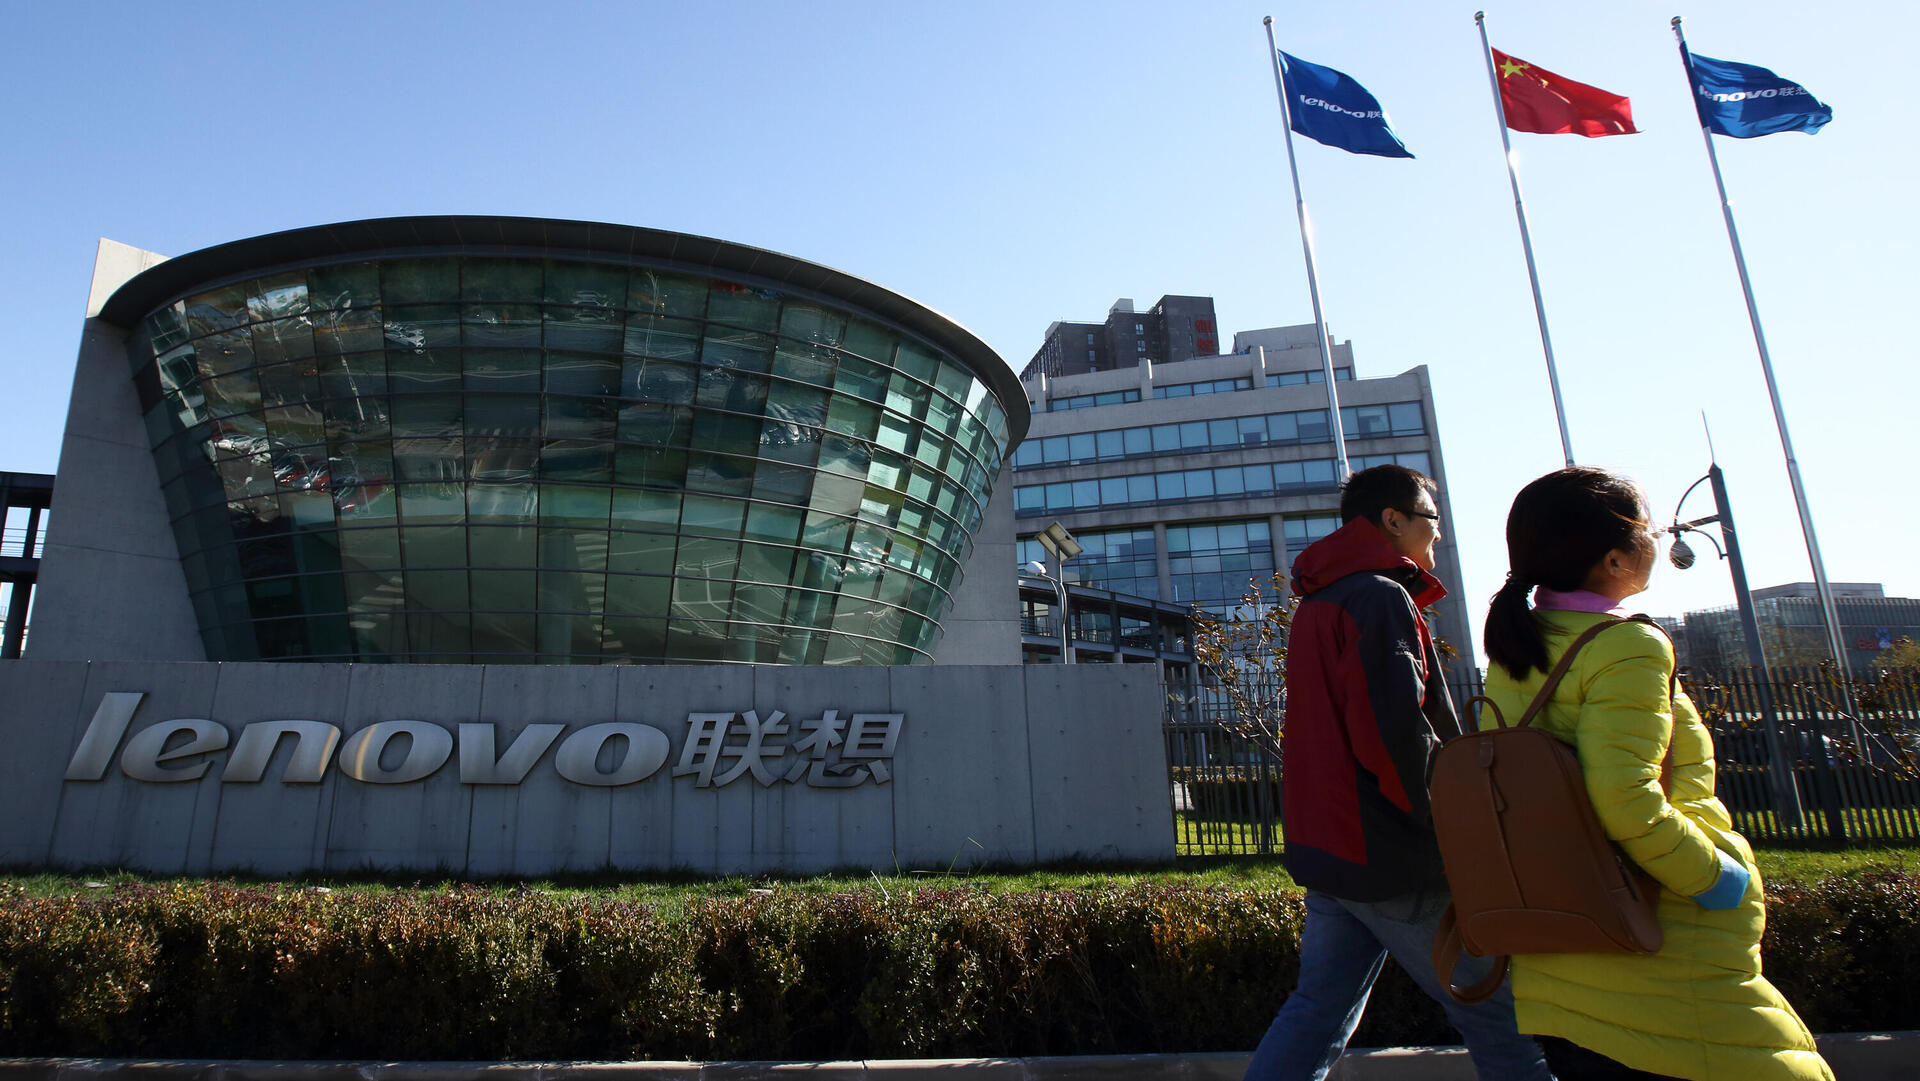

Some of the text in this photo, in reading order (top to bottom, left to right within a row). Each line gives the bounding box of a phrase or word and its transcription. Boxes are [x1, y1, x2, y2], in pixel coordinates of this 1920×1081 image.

[1698, 84, 1778, 103] lenovo
[63, 692, 904, 788] lenovo 联想
